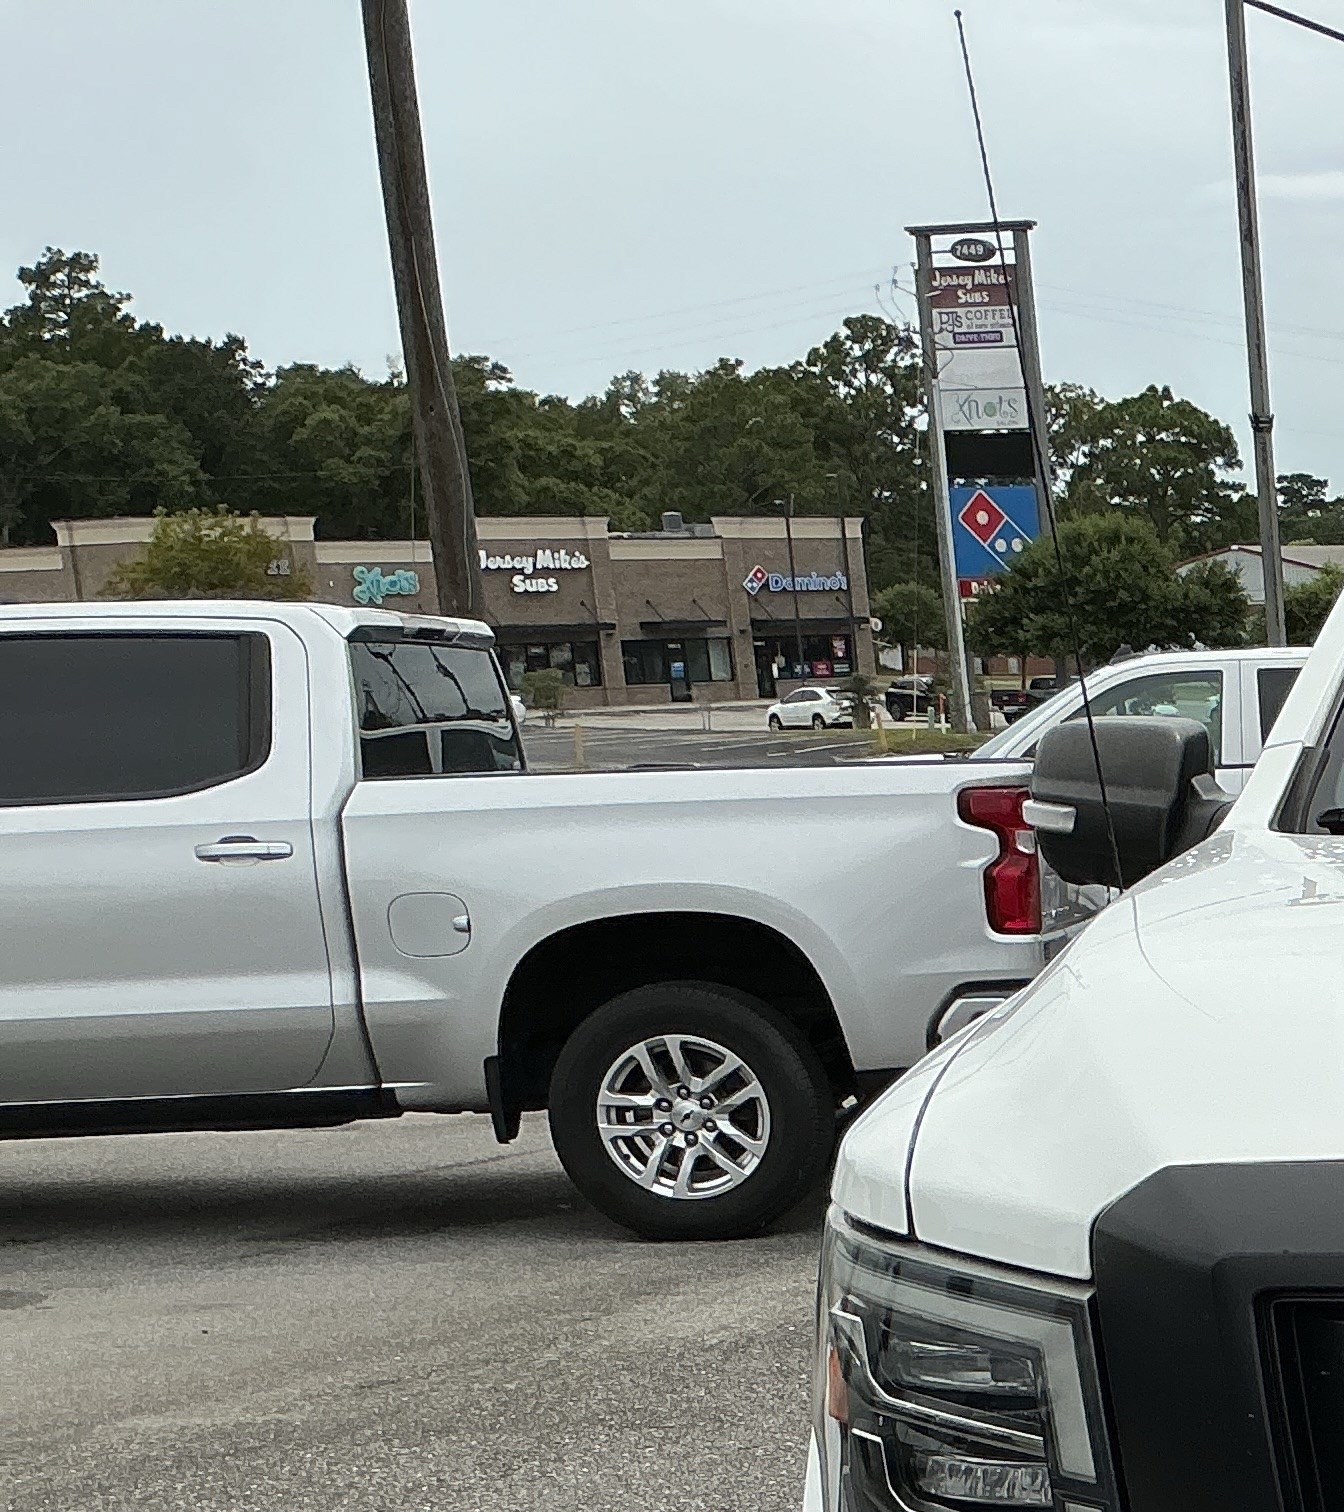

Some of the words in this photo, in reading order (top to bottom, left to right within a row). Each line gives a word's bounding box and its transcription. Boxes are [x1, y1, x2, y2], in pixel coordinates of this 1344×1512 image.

[954, 244, 985, 257] 7449
[511, 573, 559, 594] Subs
[768, 571, 848, 592] Domino's
